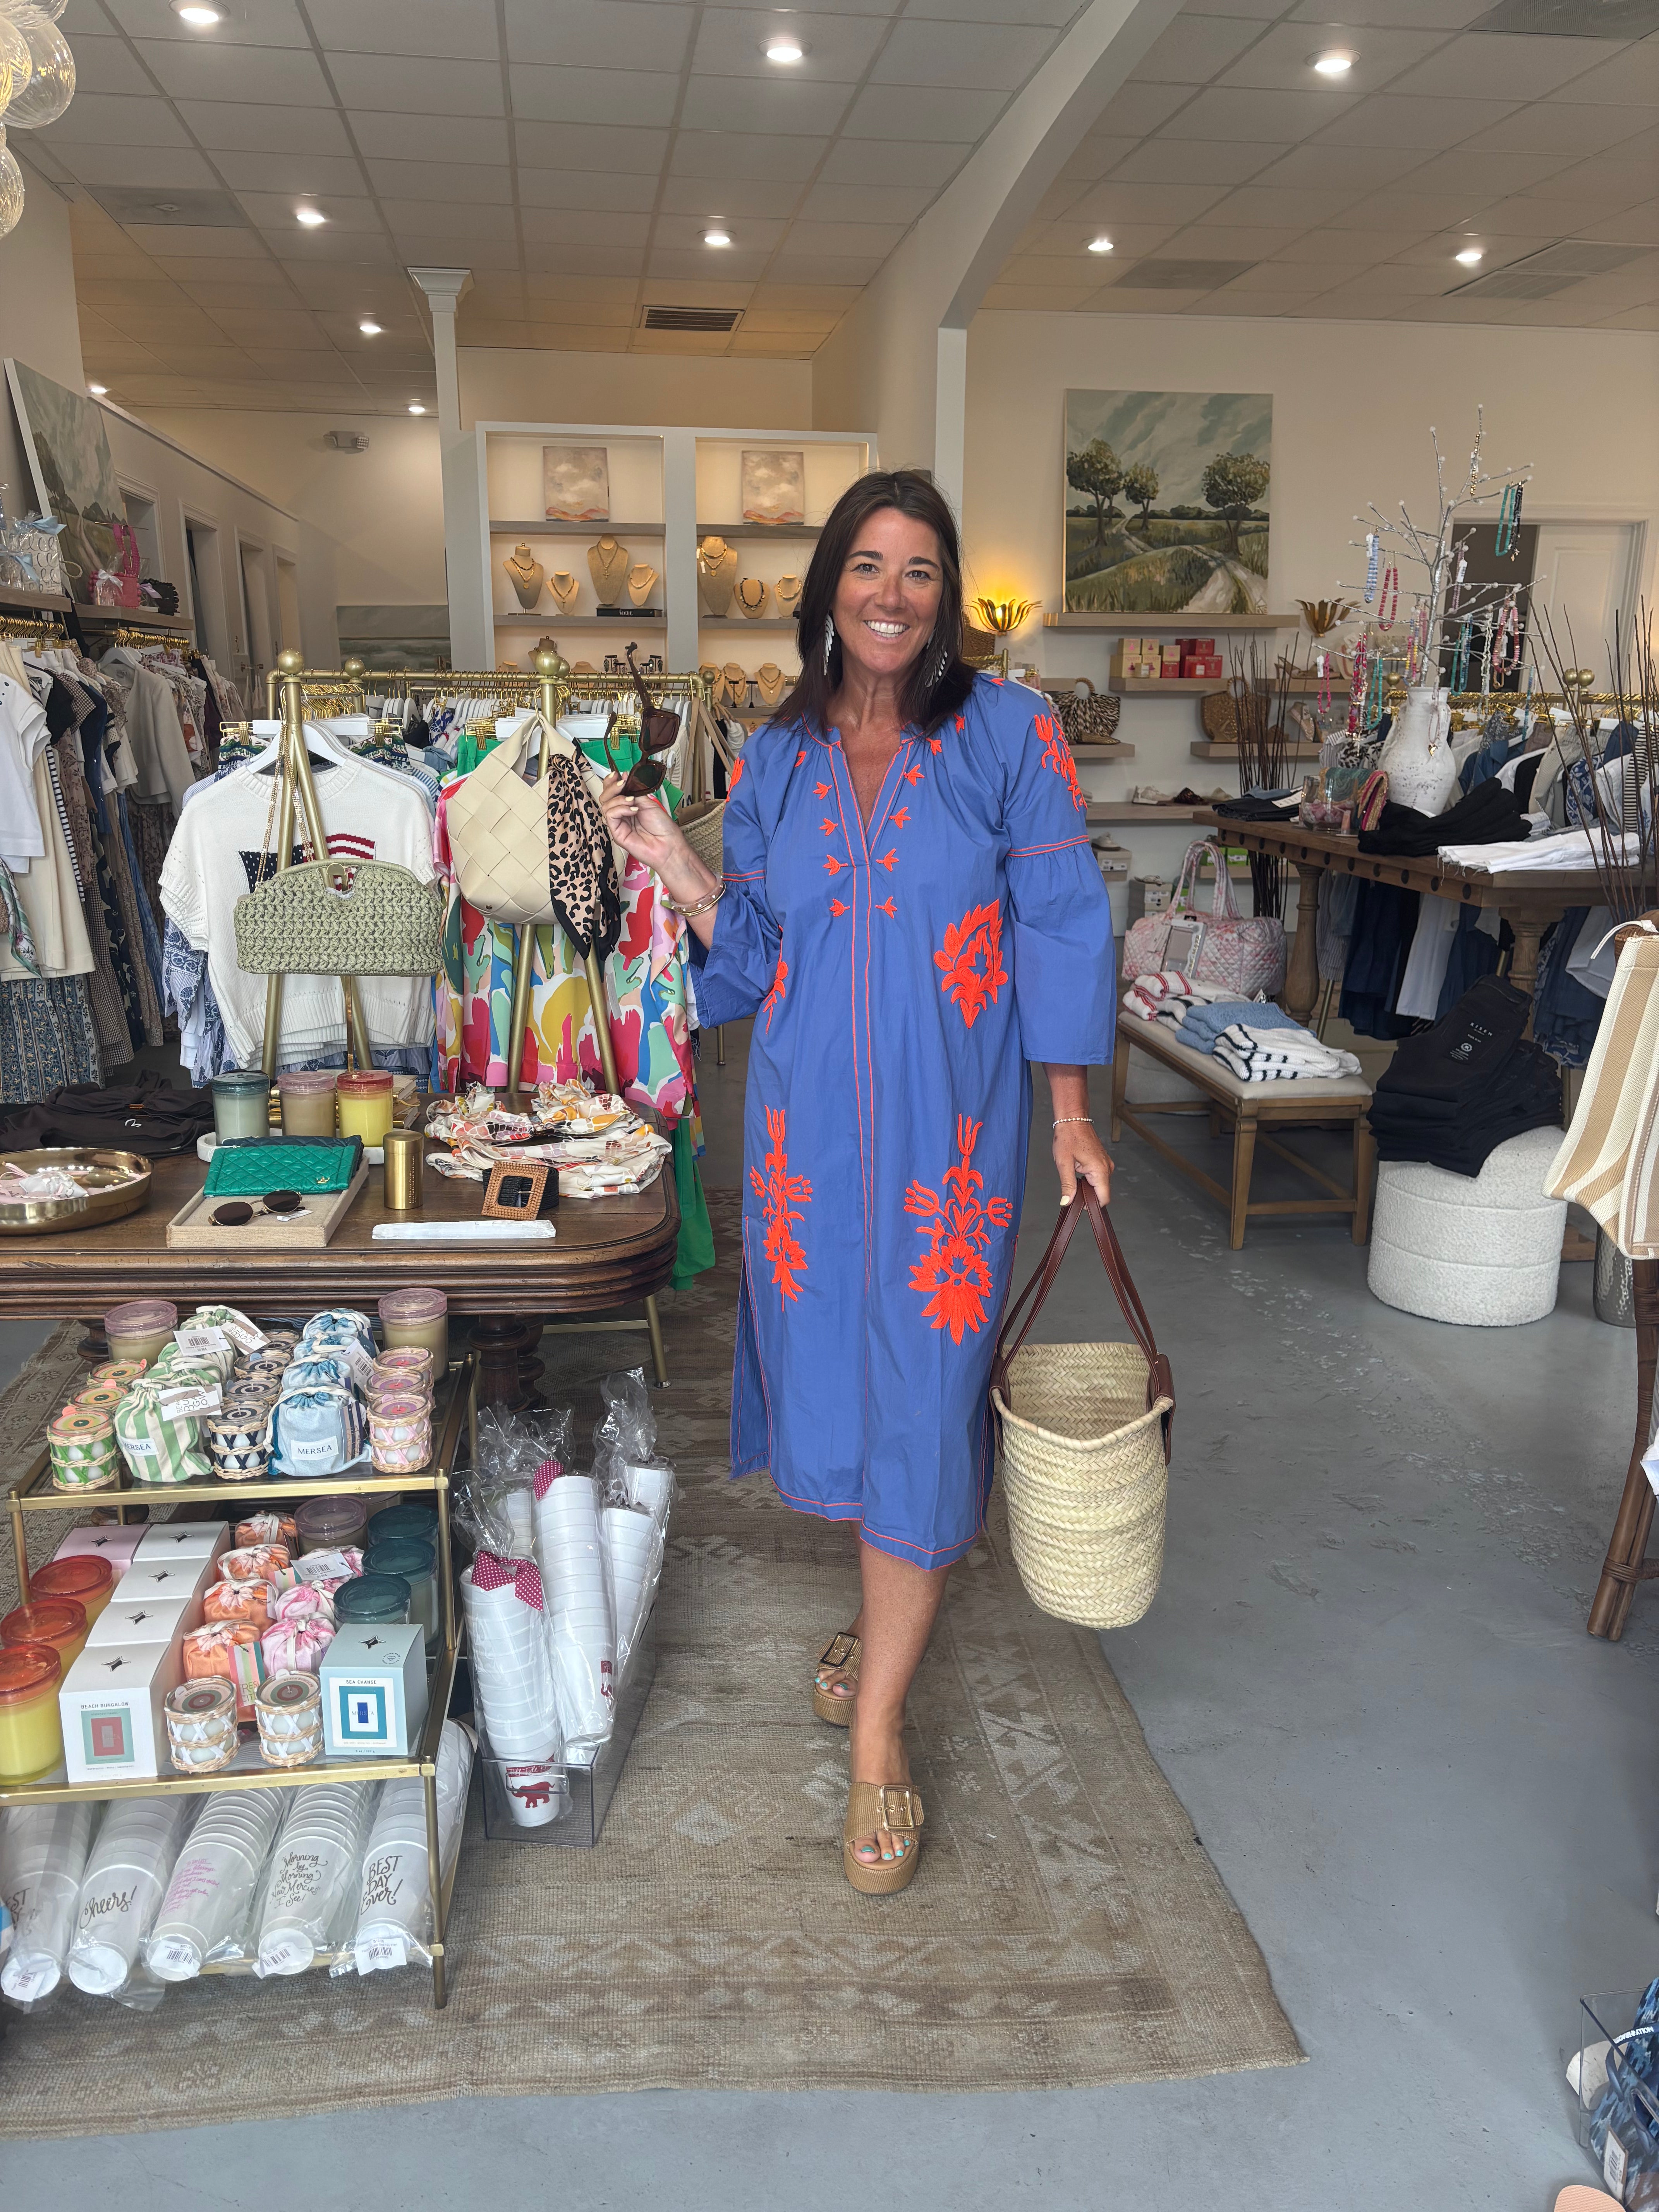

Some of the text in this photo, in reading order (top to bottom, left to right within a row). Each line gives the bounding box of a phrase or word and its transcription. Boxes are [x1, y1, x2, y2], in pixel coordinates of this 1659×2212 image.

[1470, 1022, 1492, 1036] RISEN
[298, 1445, 332, 1455] MERSEA
[239, 1681, 259, 1694] FRES
[280, 1851, 328, 1874] Morning
[292, 1862, 308, 1873] by
[366, 1855, 403, 1885] BEST
[277, 1870, 321, 1887] Morning
[367, 1873, 393, 1896] DAY
[270, 1879, 319, 1904] New Mercies
[361, 1879, 404, 1915] Ever!
[79, 1885, 137, 1930] Cheers!
